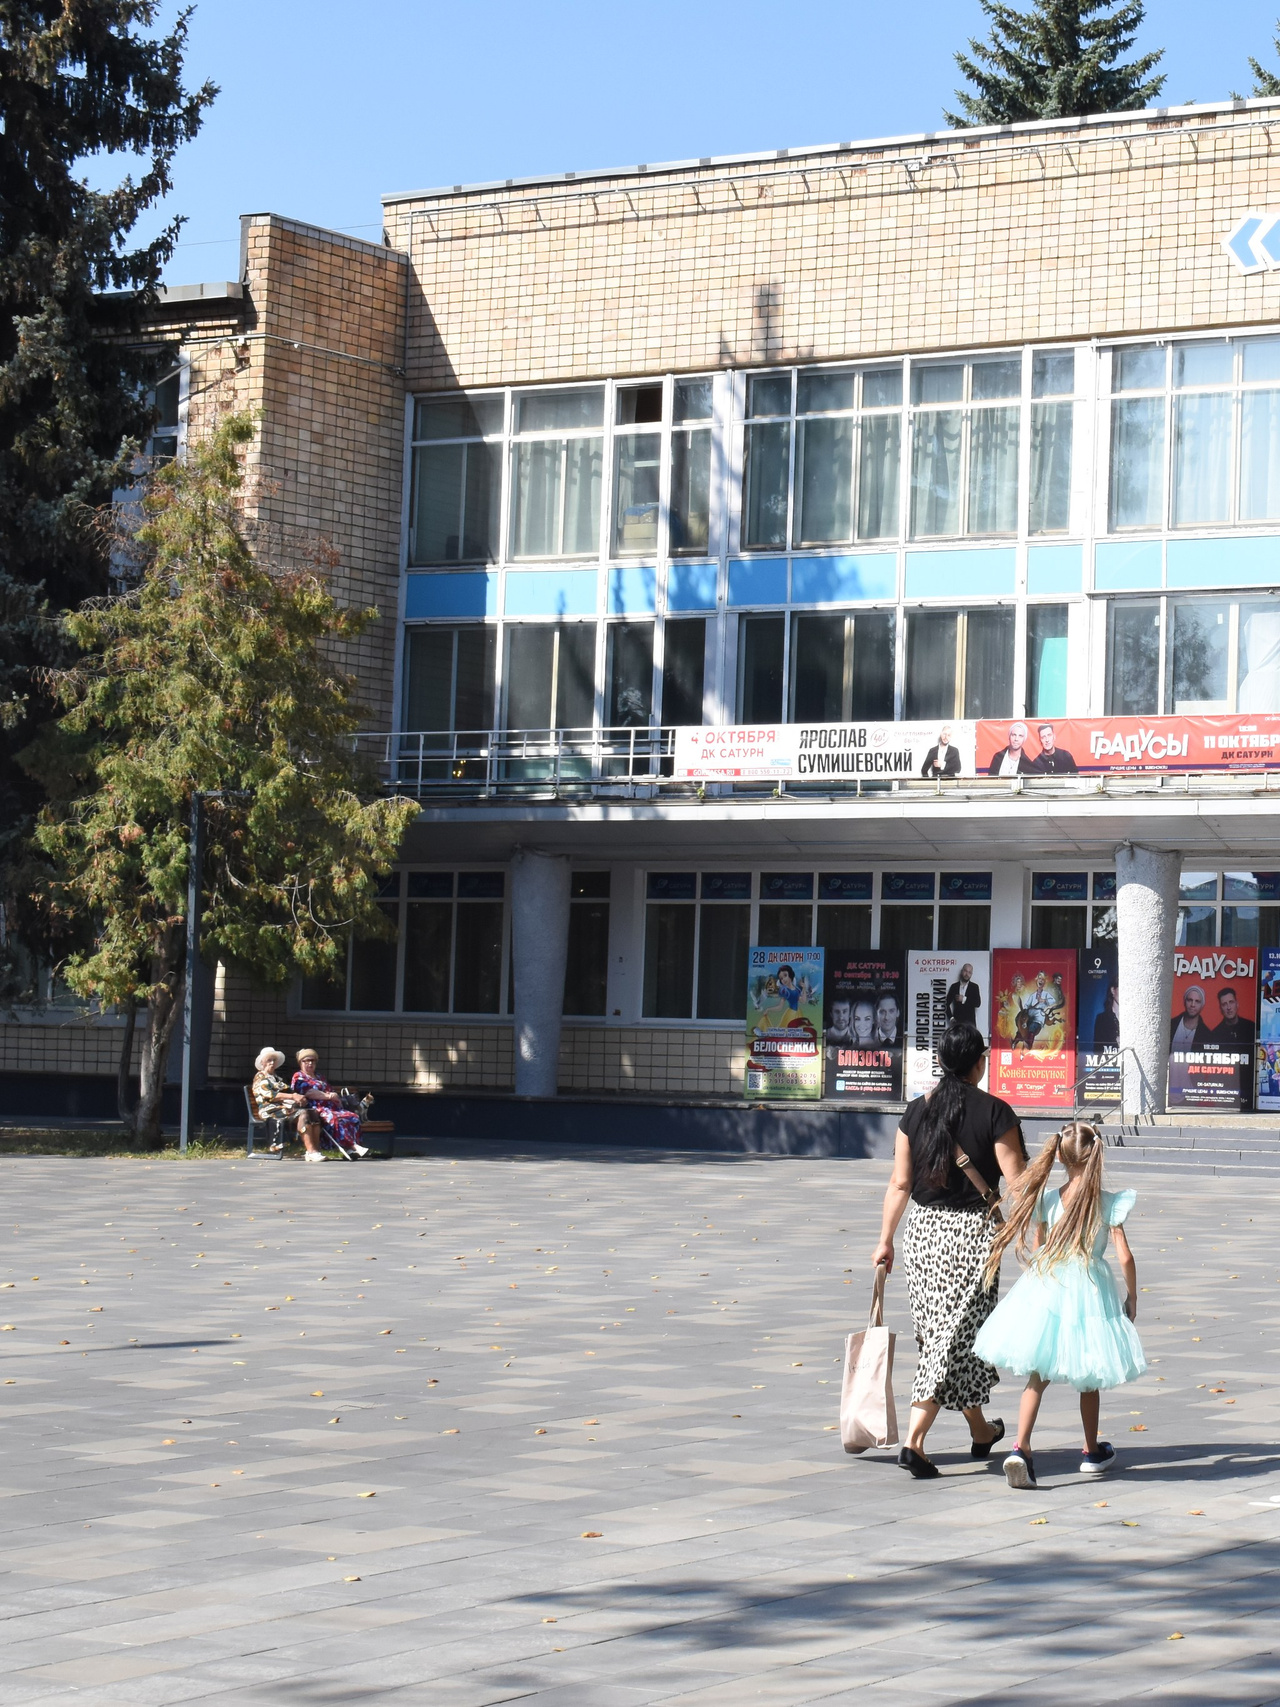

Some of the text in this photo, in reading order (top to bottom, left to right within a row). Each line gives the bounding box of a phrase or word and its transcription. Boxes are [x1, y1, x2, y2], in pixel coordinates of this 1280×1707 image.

[705, 730, 776, 744] ОКТЯБРЯ
[799, 728, 868, 750] ЯРОСЛАВ
[701, 748, 764, 760] ДК САТУРН
[1221, 751, 1274, 760] ДК САТУРН
[798, 748, 912, 774] СУМИШЕВСКИЙ
[752, 951, 765, 964] 28
[780, 952, 804, 963] САТУРН
[807, 952, 820, 960] 17:00
[1094, 957, 1102, 969] 9
[916, 992, 930, 1051] ЯРОСЛАВ
[753, 1041, 815, 1053] БЕЛОСНЕЖКА
[838, 1050, 891, 1067] БЛИЗОСТЬ
[1185, 1052, 1249, 1065] ОКТЯБРЯ
[1188, 1065, 1234, 1074] ДК САТУРН
